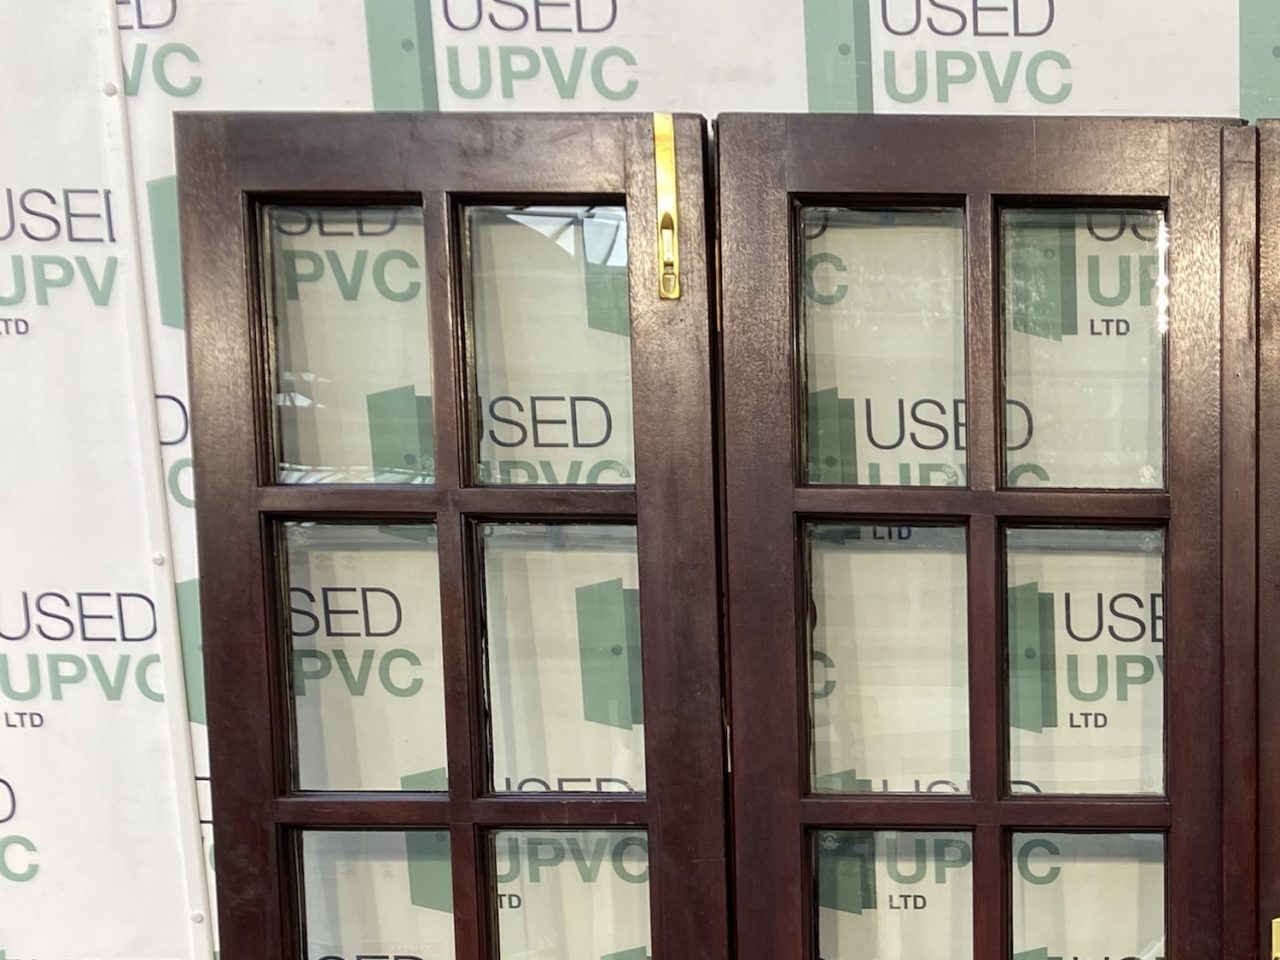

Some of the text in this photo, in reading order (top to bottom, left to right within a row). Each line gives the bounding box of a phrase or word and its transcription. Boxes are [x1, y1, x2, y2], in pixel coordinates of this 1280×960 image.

[446, 46, 639, 101] UPVC
[883, 50, 1073, 104] UPVC
[283, 249, 422, 302] PVC
[0, 318, 29, 336] TD
[1089, 318, 1130, 336] LTD
[481, 396, 613, 448] SED
[290, 587, 402, 637] SED
[293, 649, 424, 698] PVC
[4, 711, 44, 728] LTD
[1069, 712, 1108, 729] LTD
[497, 894, 522, 910] TD
[888, 894, 927, 911] LTD
